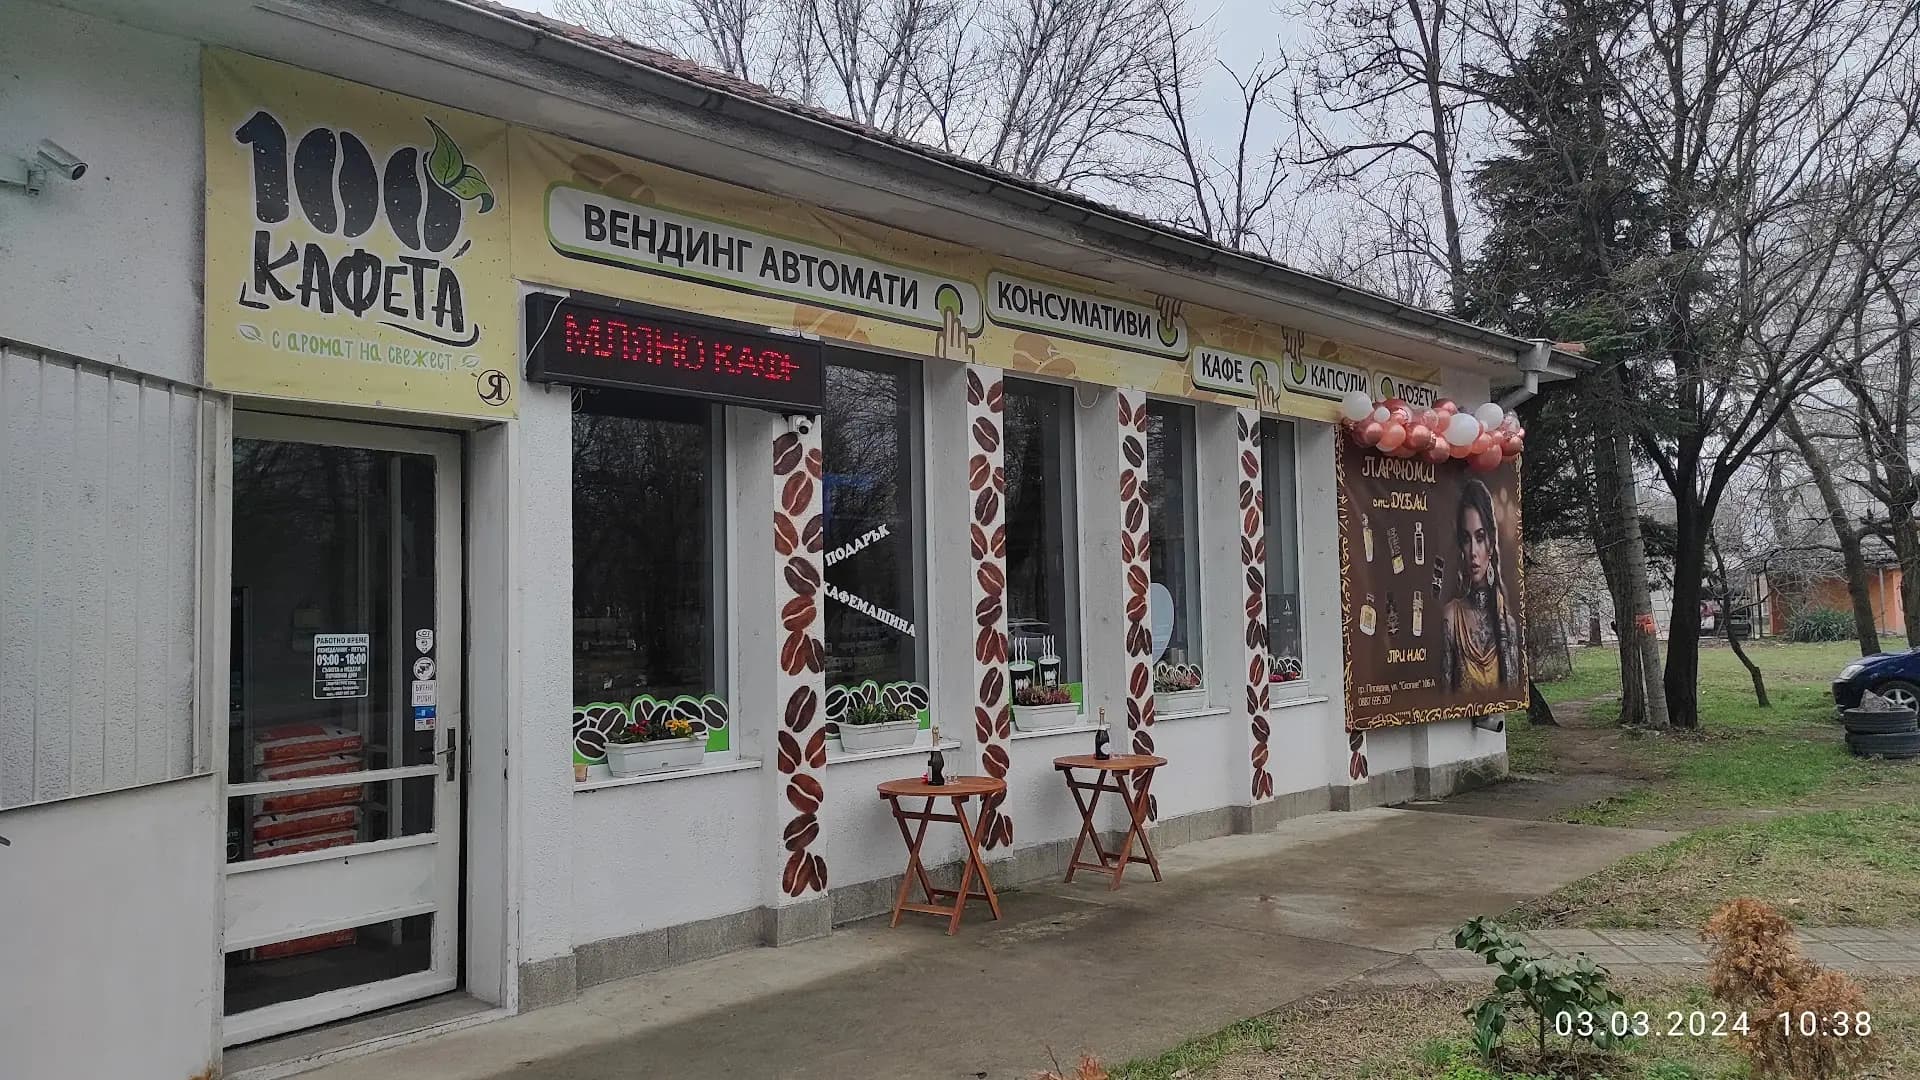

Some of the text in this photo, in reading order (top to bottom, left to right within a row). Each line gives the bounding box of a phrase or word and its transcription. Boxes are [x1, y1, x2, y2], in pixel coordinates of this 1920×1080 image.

[235, 111, 462, 252] 100
[583, 203, 918, 311] ВЕНДИНГ АВТОМАТИ
[252, 230, 466, 334] КАФЕТА
[997, 280, 1152, 340] КОНСУМАТИВИ
[288, 332, 354, 359] аромат
[360, 342, 382, 361] на
[388, 346, 453, 370] свежест
[565, 313, 706, 371] МЛЯНО
[1201, 353, 1244, 384] КАФЕ
[1311, 364, 1367, 394] КАПСУЛИ
[1362, 455, 1437, 484] ПАРФЮМИ
[1391, 490, 1428, 511] ДУБАЙ
[825, 523, 891, 567] ПОДАРЪК
[823, 580, 916, 638] КАФЕМАШИНА
[345, 653, 367, 665] 18:00
[1387, 649, 1406, 663] ПРИ
